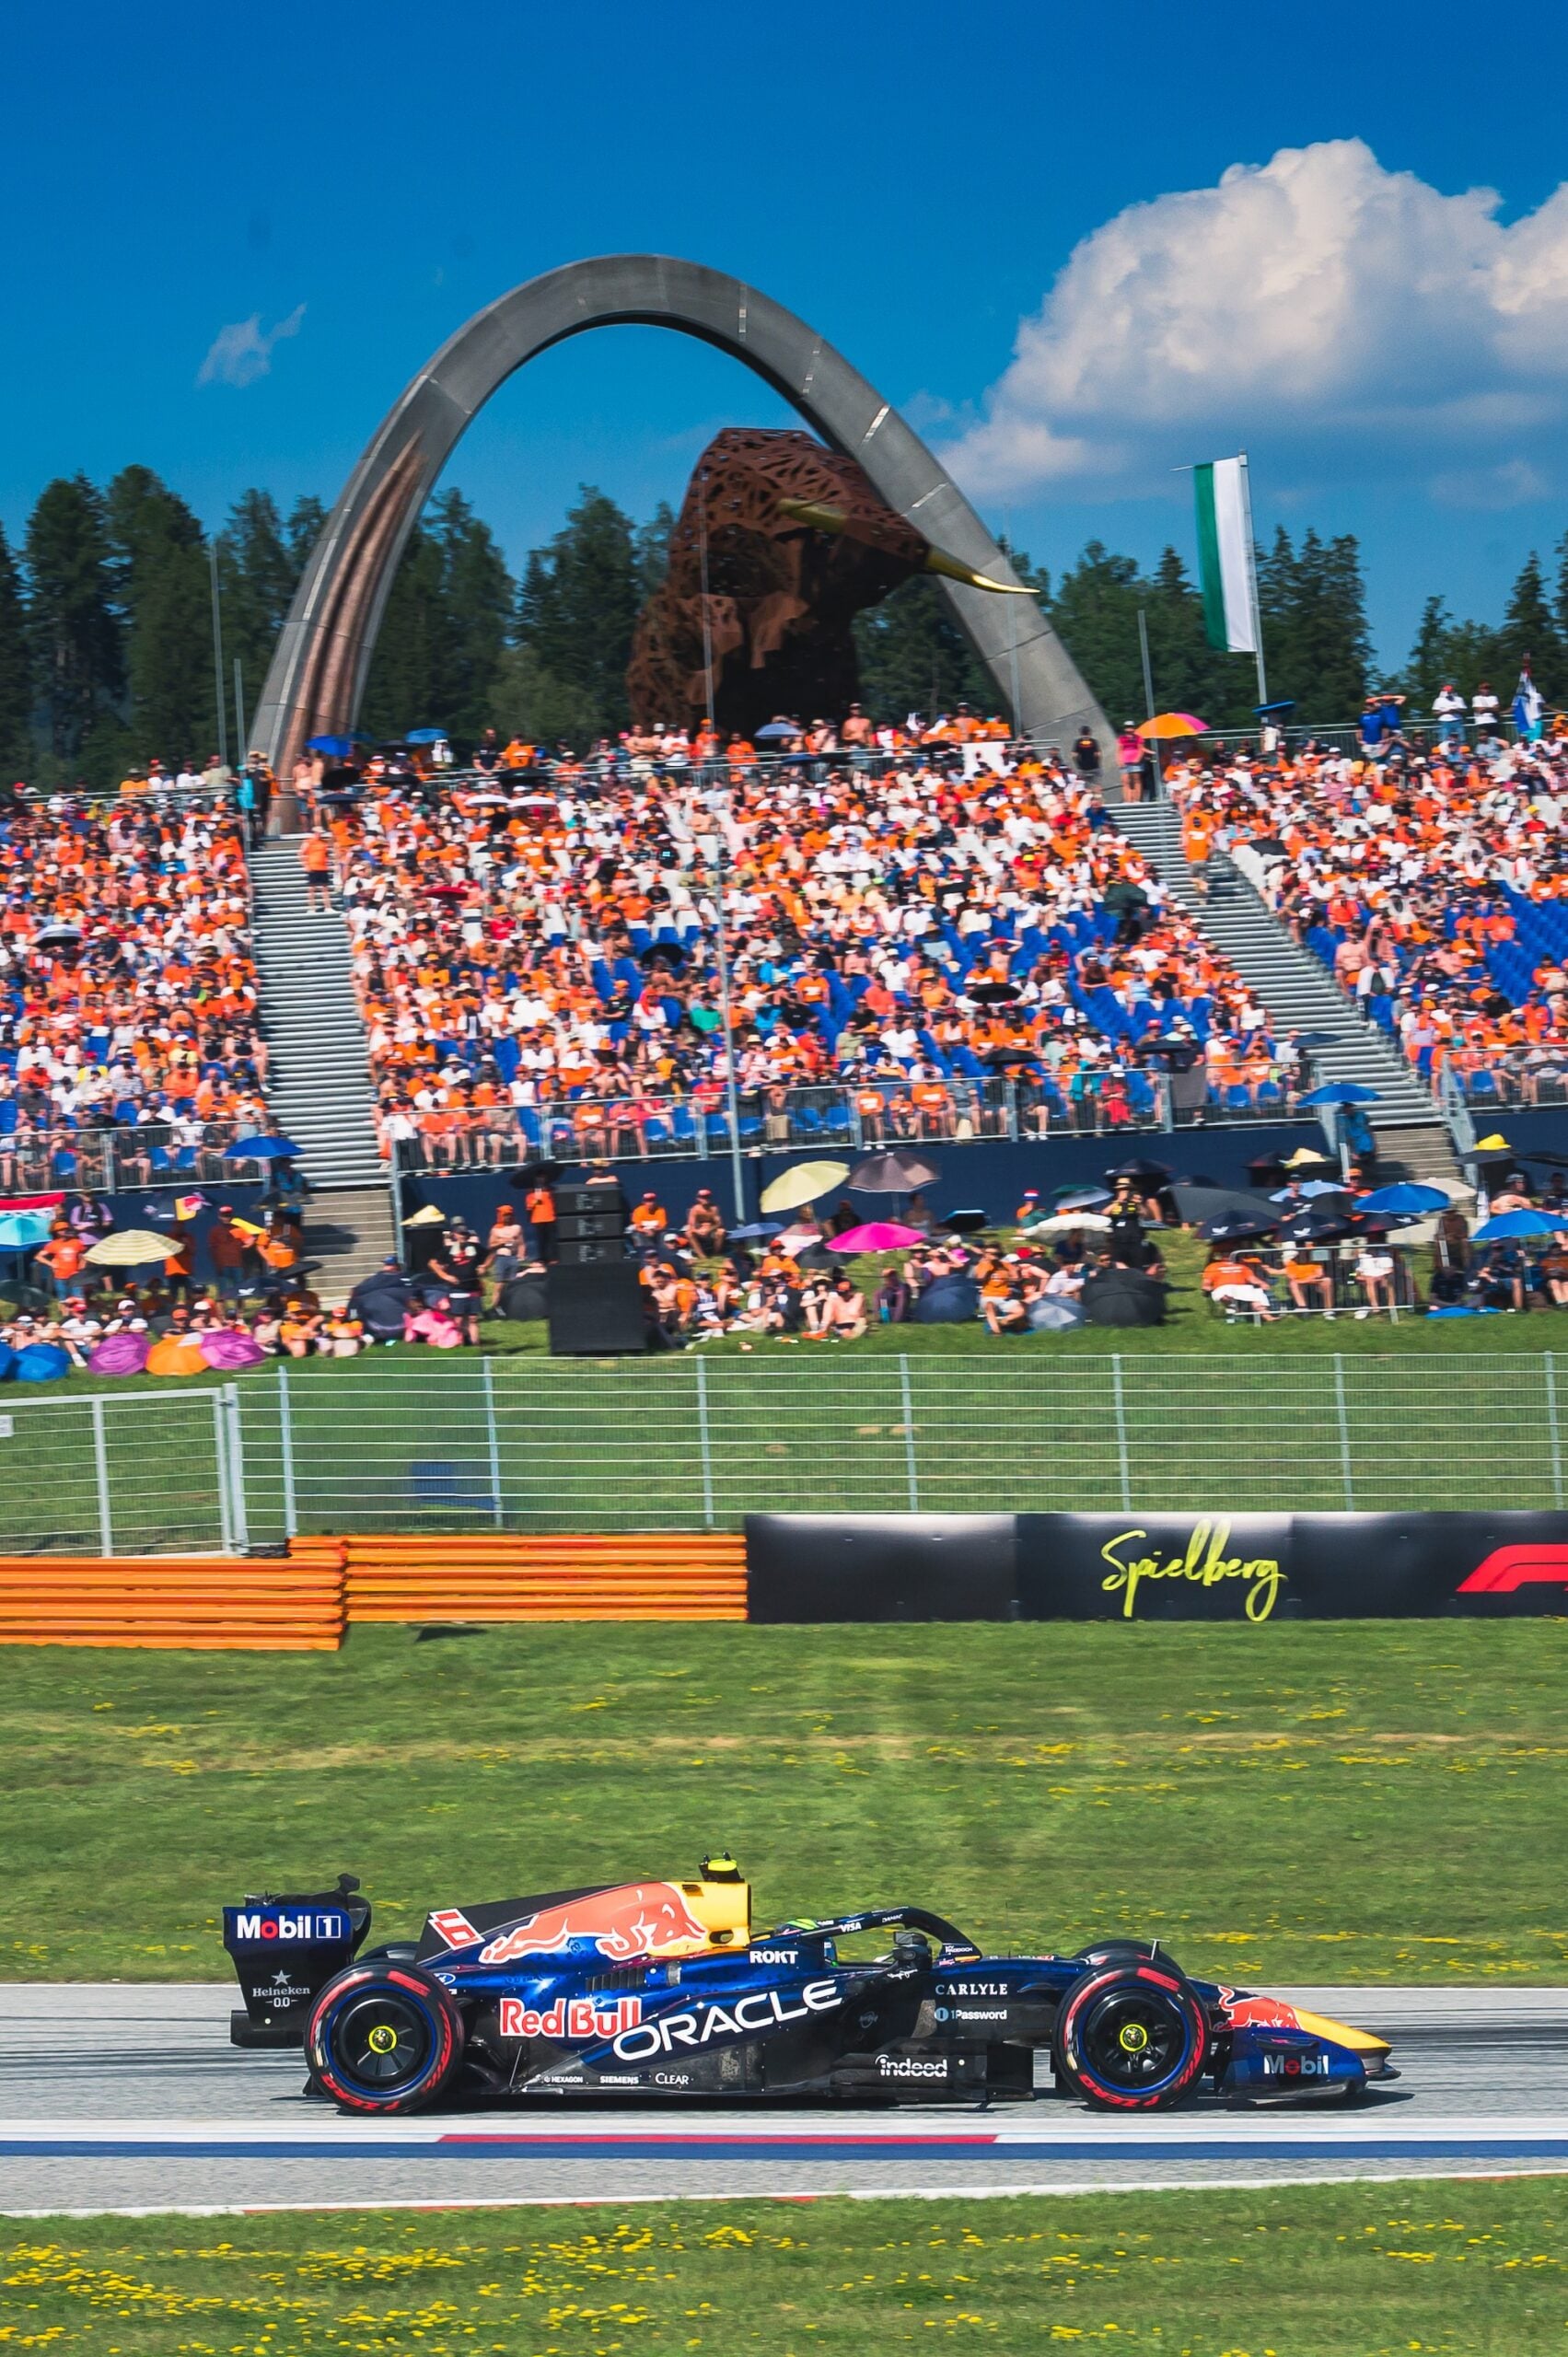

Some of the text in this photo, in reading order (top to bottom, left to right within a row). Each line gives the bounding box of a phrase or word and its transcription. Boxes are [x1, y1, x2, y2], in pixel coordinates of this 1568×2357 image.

[1101, 1518, 1287, 1621] Spielberg
[237, 1915, 310, 1939] Mobil
[841, 1922, 862, 1933] VISA
[749, 1951, 798, 1964] ROKT
[252, 1986, 310, 1997] Heineken
[935, 1983, 1008, 1996] CARLYLE
[500, 1997, 643, 2038] Red Bull
[613, 1980, 842, 2061] ORACLE
[950, 2009, 1007, 2020] 1Password
[876, 2054, 947, 2077] indeed
[1264, 2054, 1329, 2075] Mobil
[599, 2075, 639, 2084] SIEMENS
